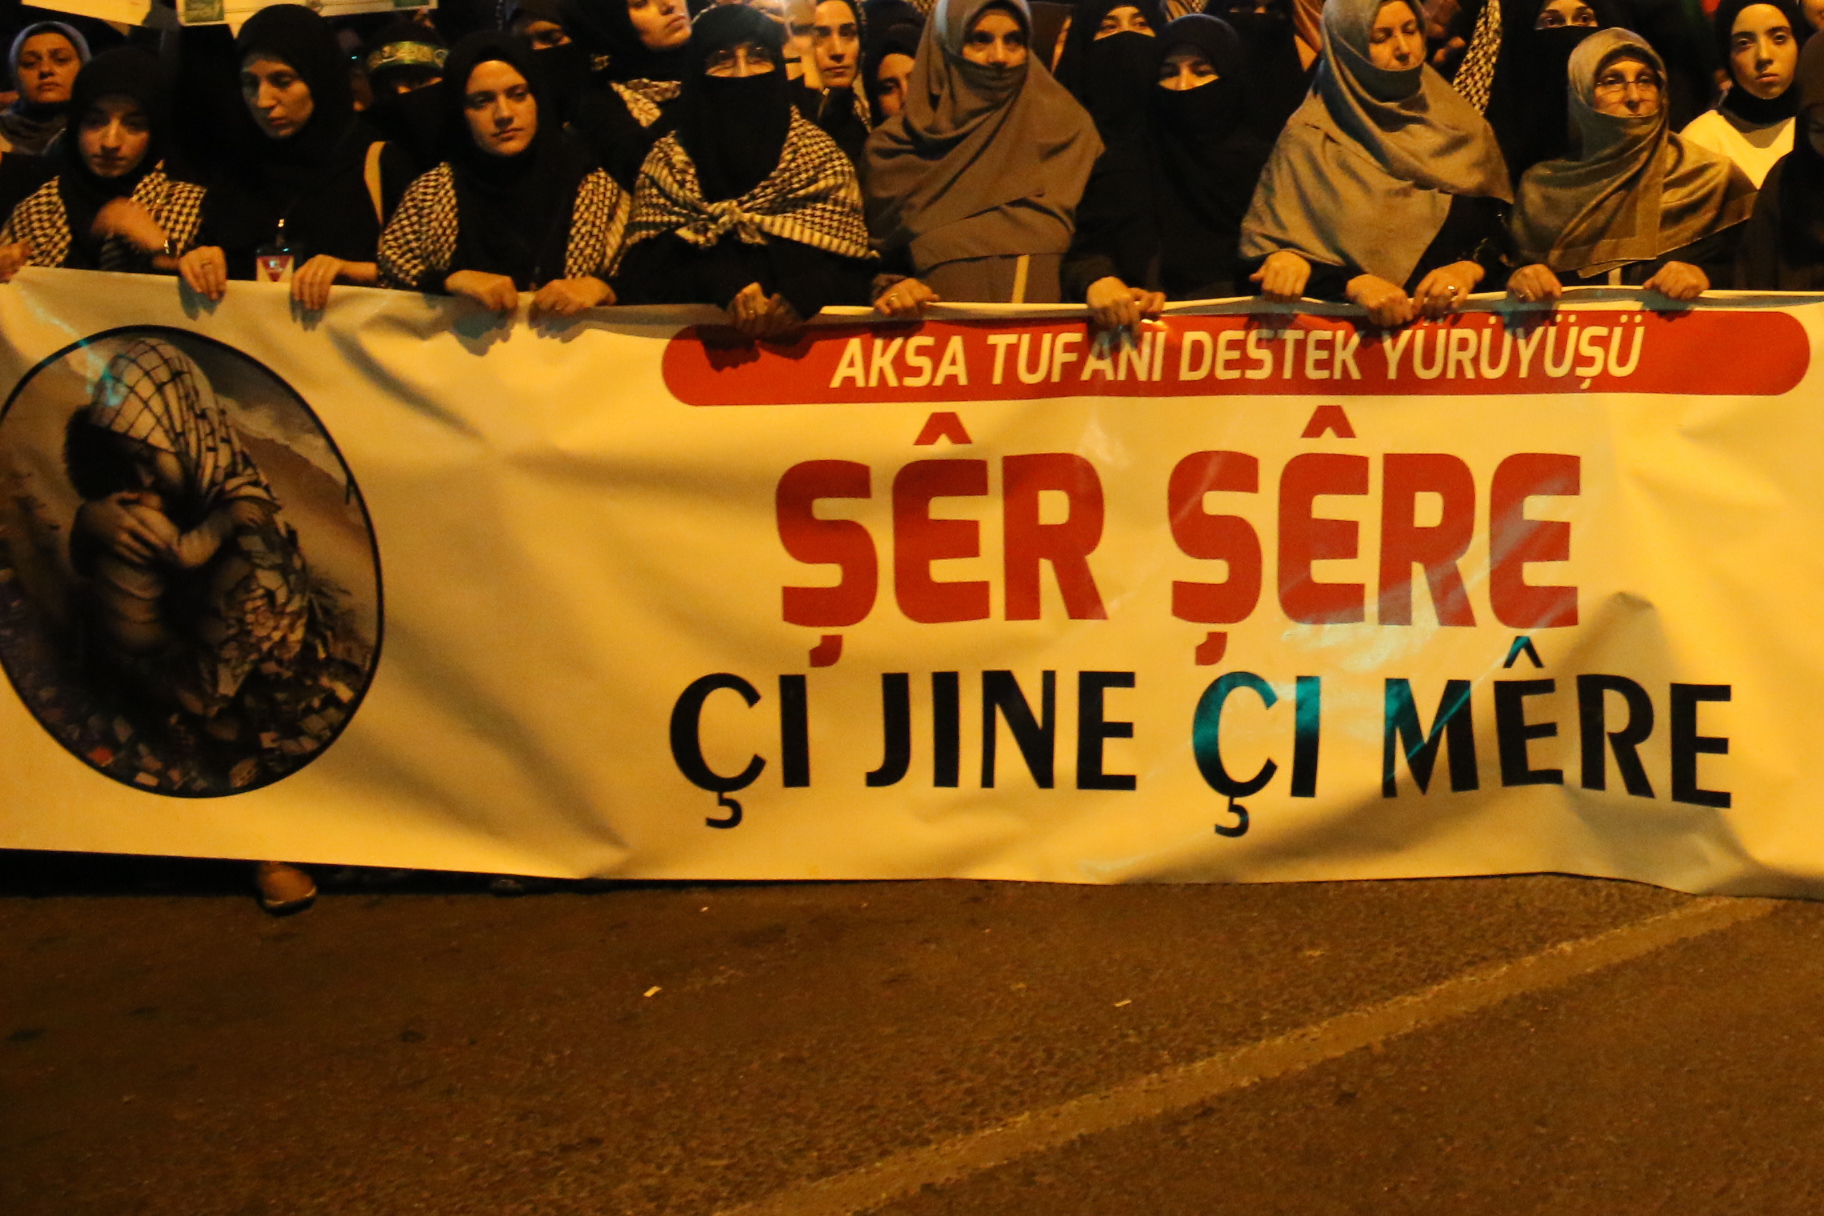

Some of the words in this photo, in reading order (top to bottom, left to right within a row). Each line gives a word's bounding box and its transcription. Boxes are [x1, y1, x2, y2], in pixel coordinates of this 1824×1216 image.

[830, 335, 968, 388] AKSA
[1179, 329, 1361, 382] DESTEK
[1383, 314, 1645, 390] YÜRÜYÜŞÜ
[774, 411, 1109, 668] ŞÊR
[1166, 405, 1582, 667] ŞÊRE
[668, 671, 812, 830] ÇI
[865, 669, 1138, 794] JINE
[1190, 671, 1321, 839] ÇI
[1381, 635, 1733, 809] MÊRE
